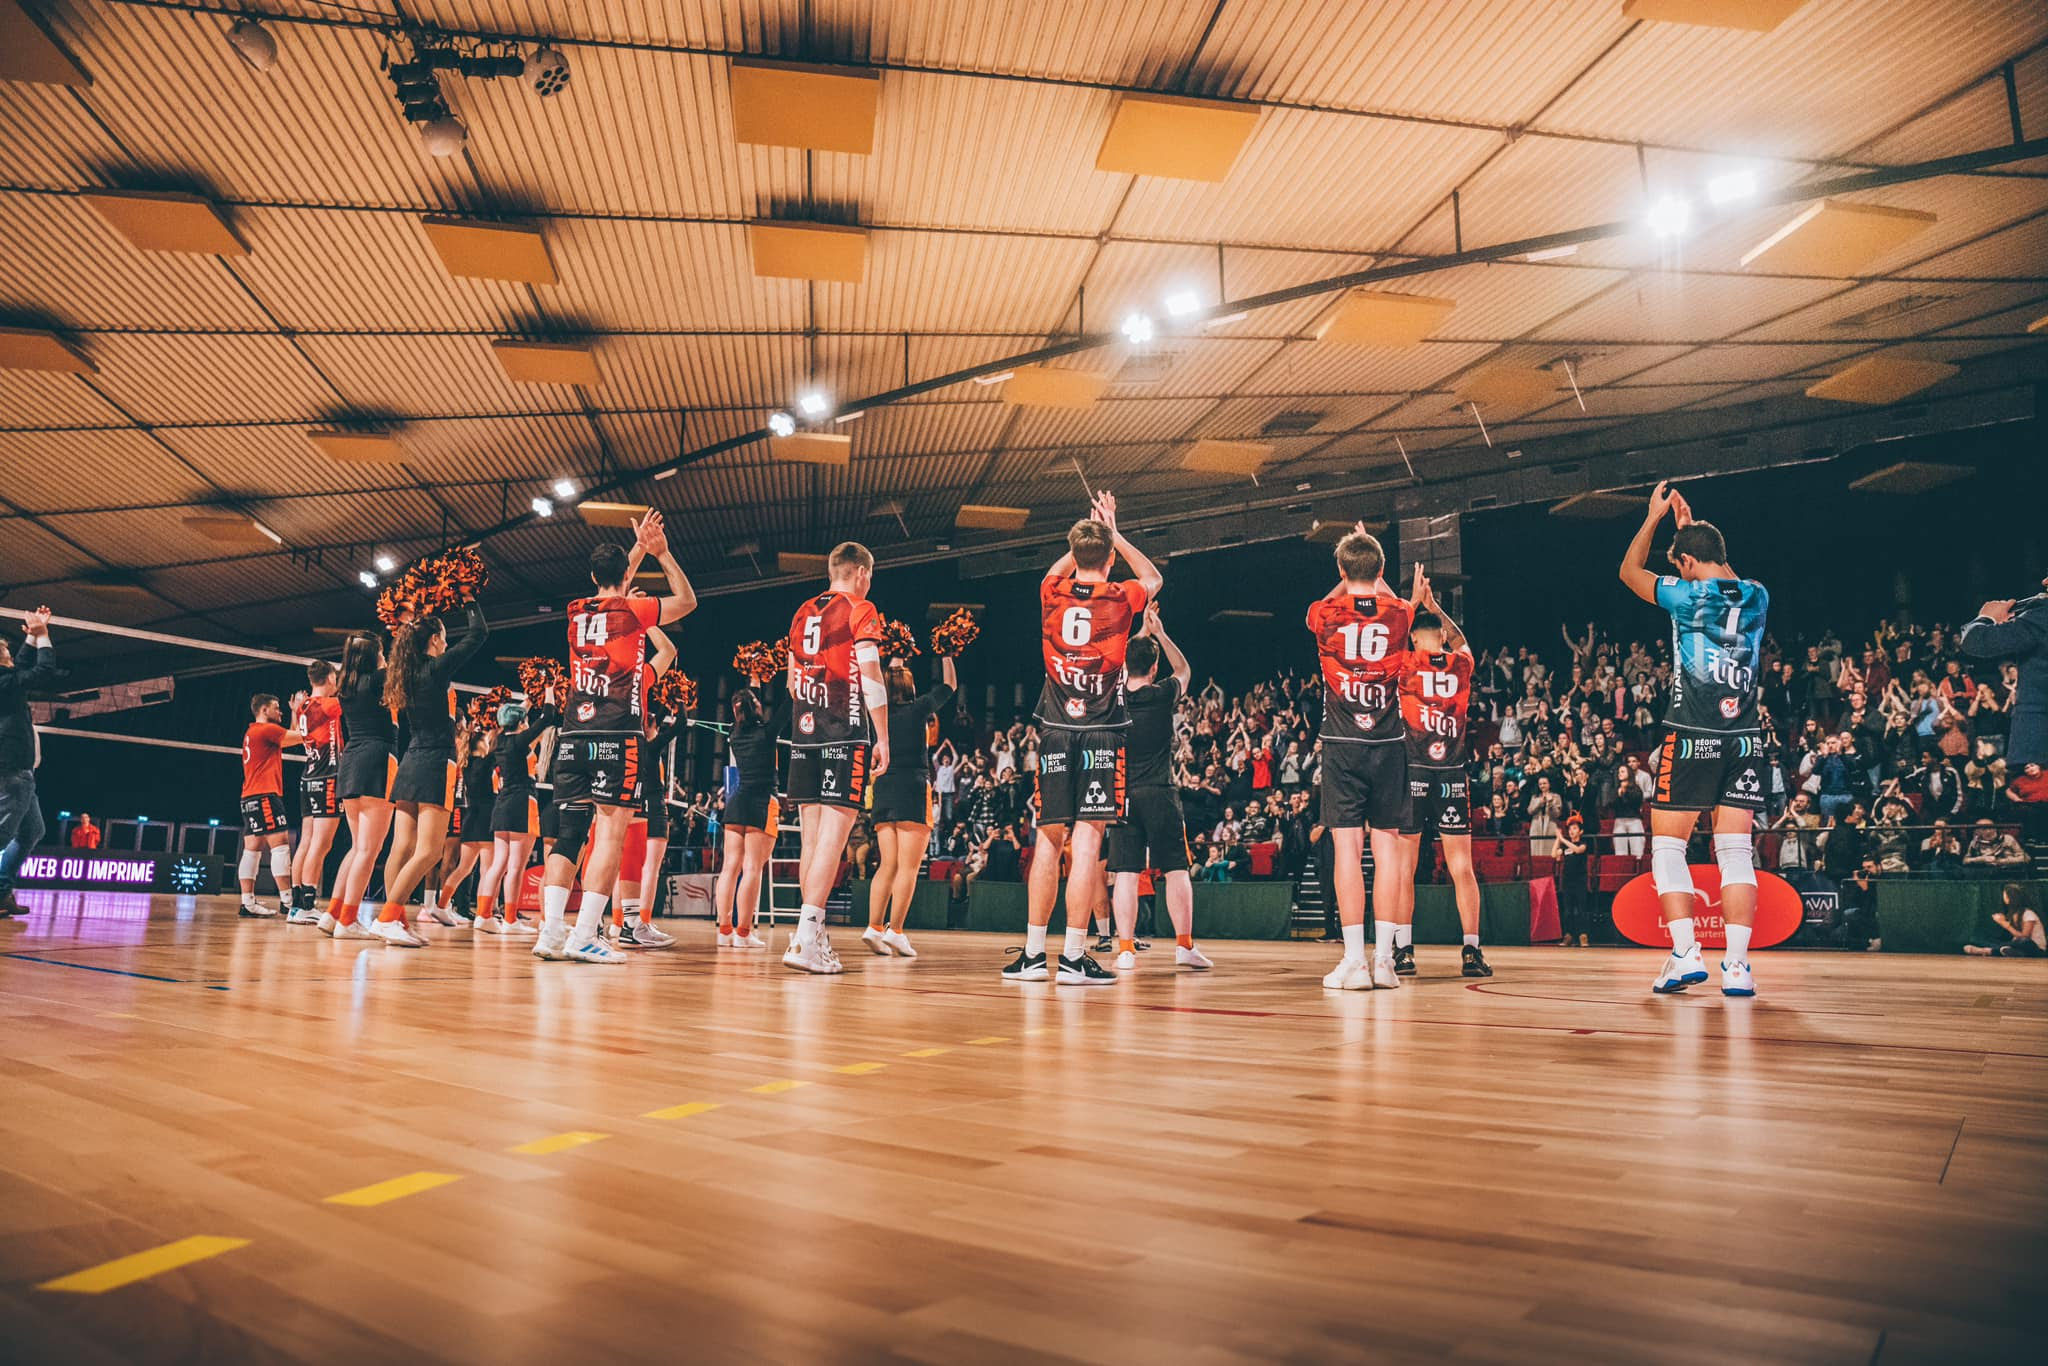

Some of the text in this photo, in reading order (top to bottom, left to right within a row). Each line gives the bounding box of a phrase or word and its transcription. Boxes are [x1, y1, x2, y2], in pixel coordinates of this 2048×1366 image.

[573, 612, 609, 648] 14
[802, 615, 822, 655] 5
[1062, 606, 1092, 646] 6
[1726, 607, 1741, 636] 1
[1337, 623, 1390, 662] 16
[1417, 670, 1459, 698] 15
[299, 714, 308, 737] 9
[1695, 738, 1721, 746] RÉGION
[849, 745, 865, 803] LAVA
[1656, 731, 1677, 803] LAVAL
[276, 815, 287, 826] 13
[21, 857, 155, 882] WEB OU IMPRIMÉ
